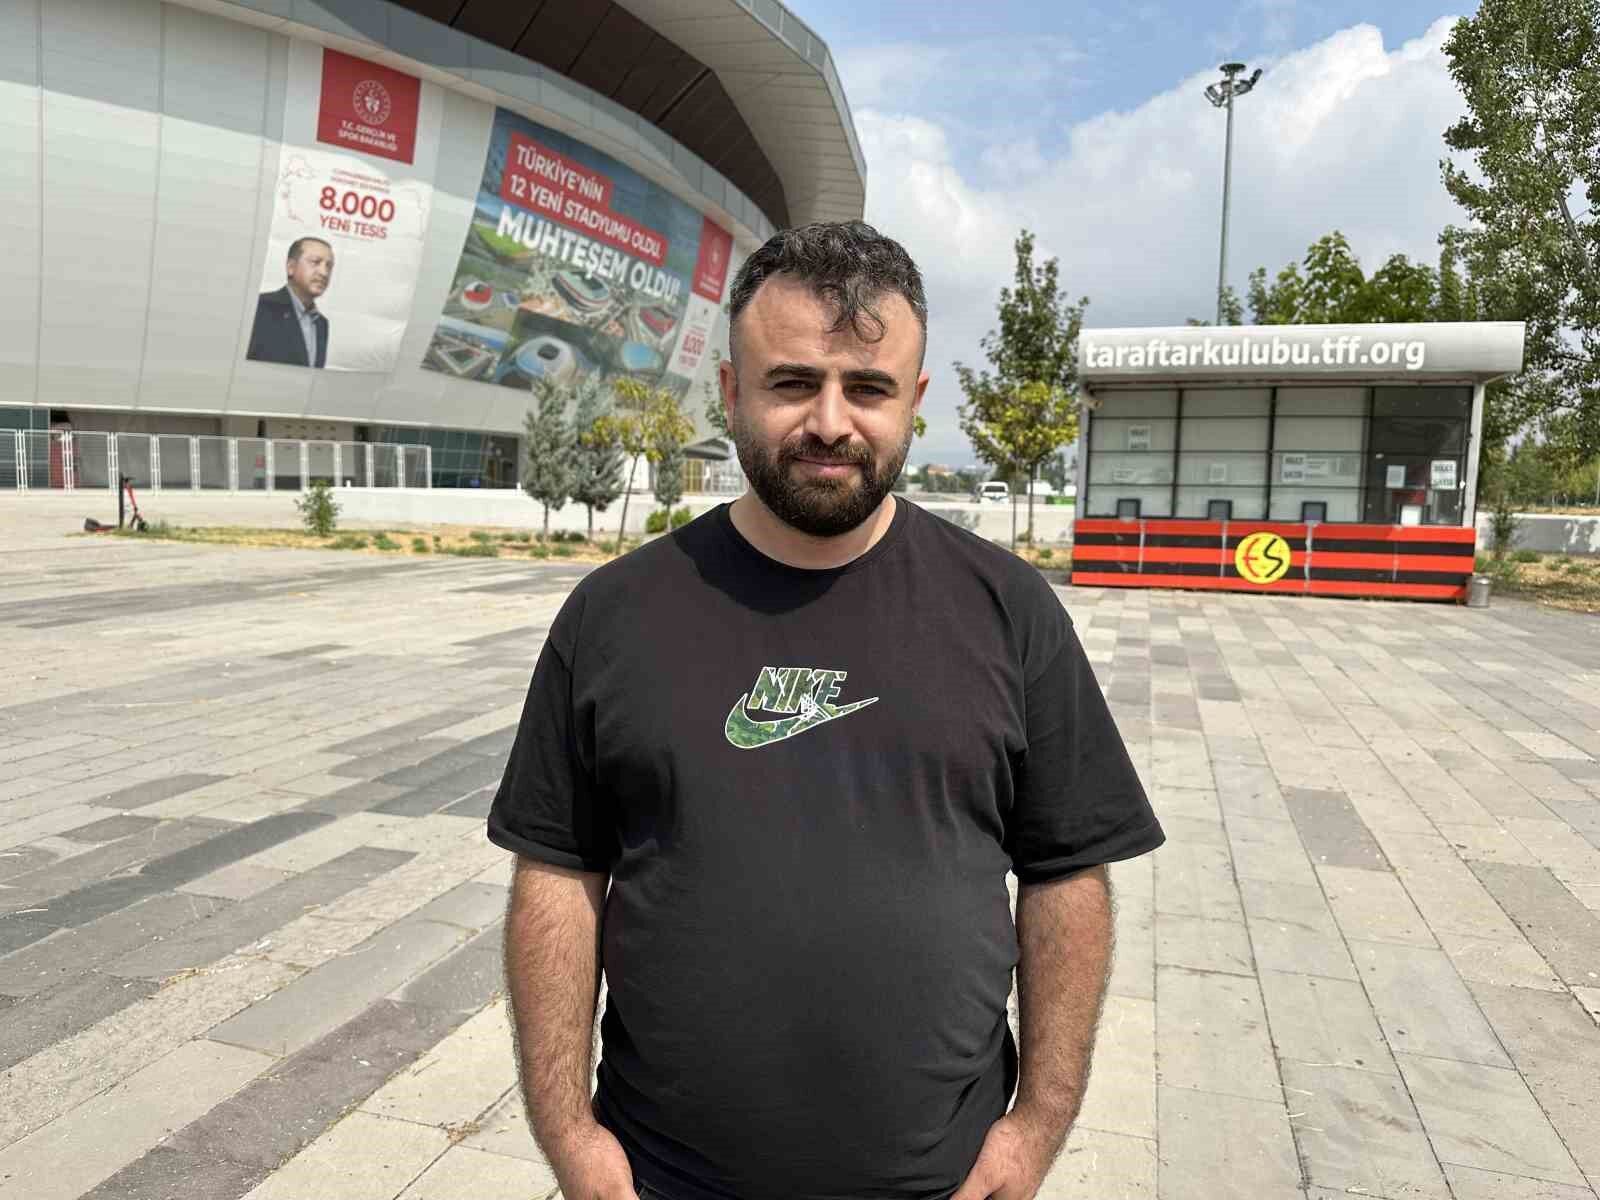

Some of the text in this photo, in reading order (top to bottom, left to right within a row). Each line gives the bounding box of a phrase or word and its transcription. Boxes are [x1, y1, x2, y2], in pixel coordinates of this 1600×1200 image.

[516, 143, 604, 203] TÜRKİYE'NİN
[319, 185, 395, 223] 8.000
[511, 174, 527, 198] 12
[529, 182, 565, 213] YENİ
[563, 199, 632, 243] STADYUMU
[496, 204, 631, 283] MUHTEŞEM
[1085, 335, 1426, 371] taraftarkulubu.tff.org
[747, 666, 848, 714] NIKE
